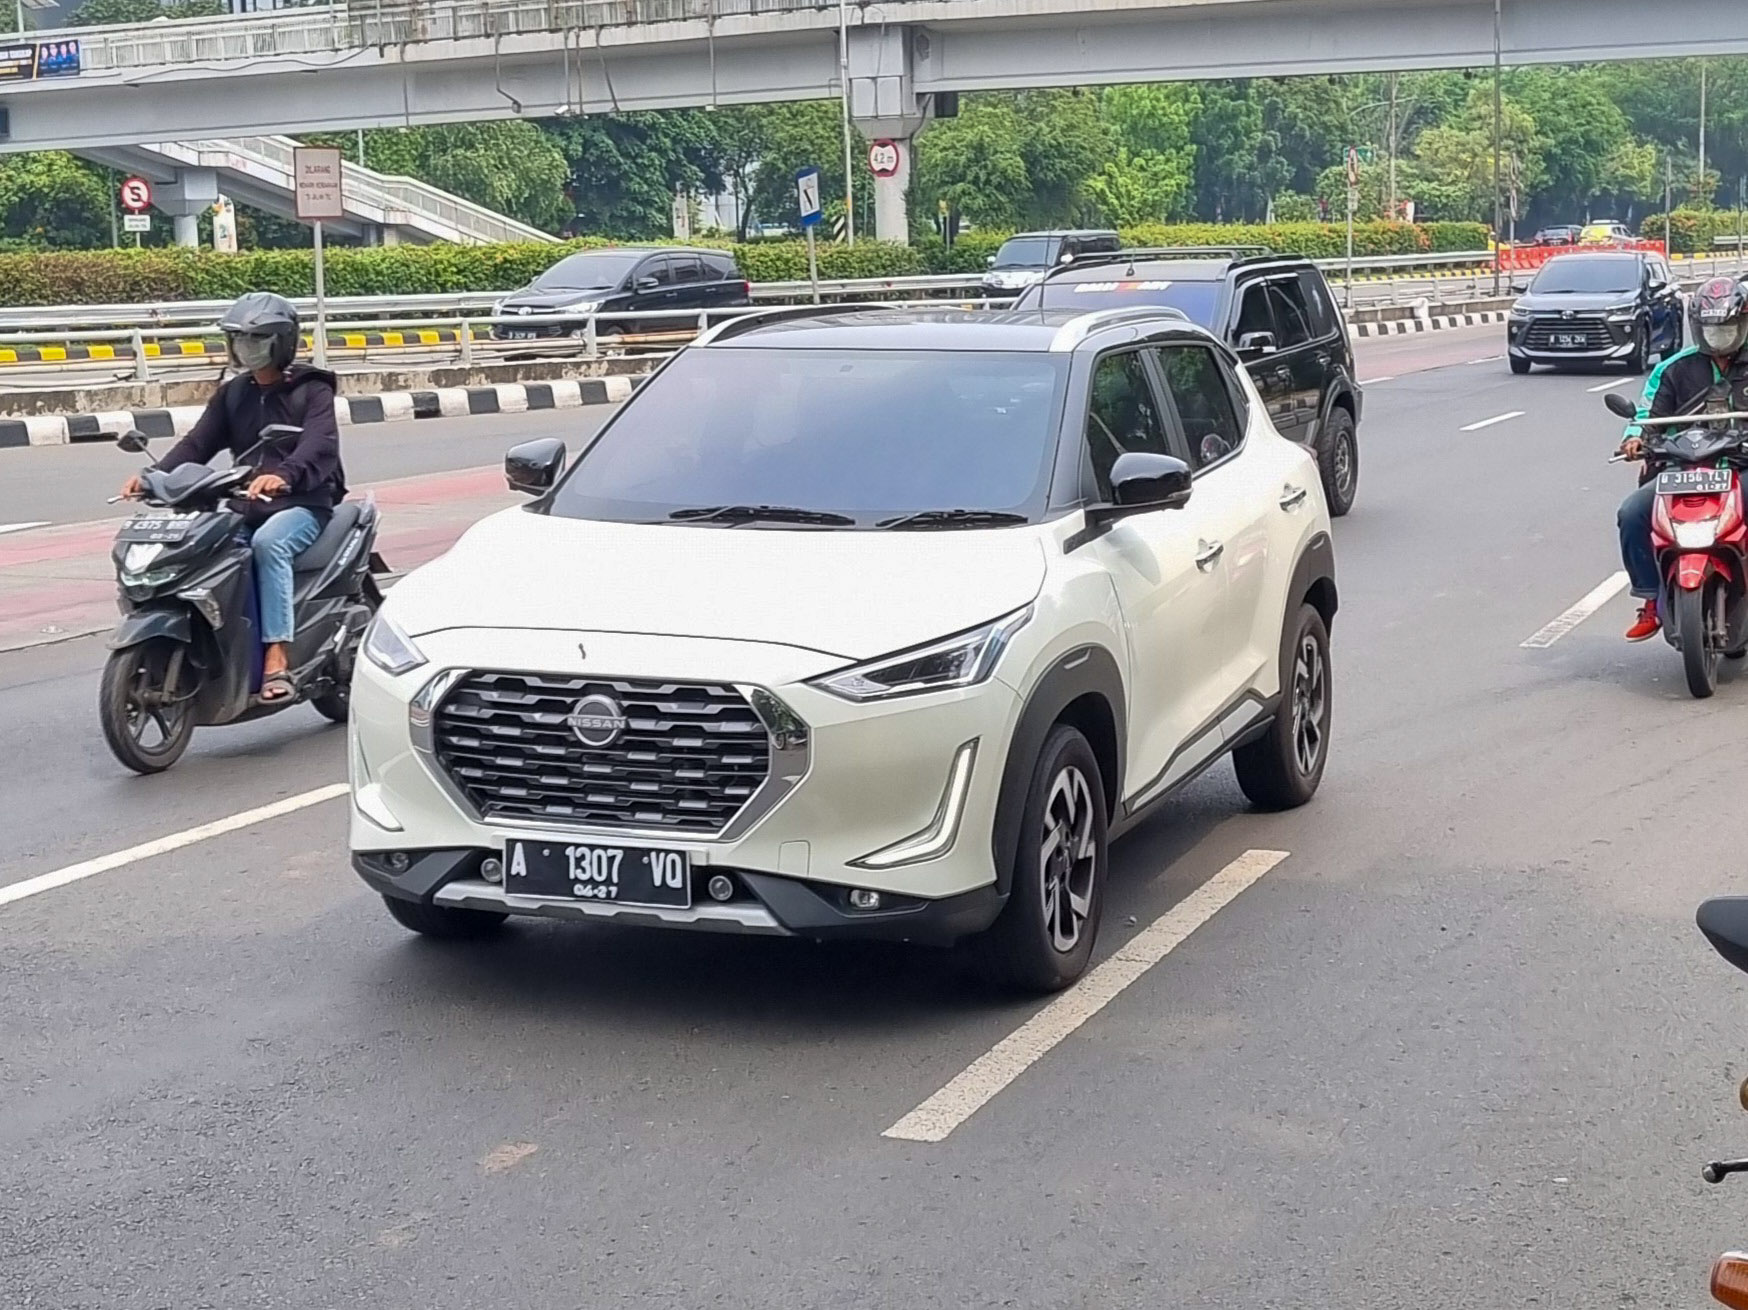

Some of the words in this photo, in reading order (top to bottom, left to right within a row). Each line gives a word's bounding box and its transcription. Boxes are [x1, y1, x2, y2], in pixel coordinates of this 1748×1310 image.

[567, 717, 626, 729] NISSAN
[510, 842, 527, 877] A
[565, 846, 624, 884] 1307
